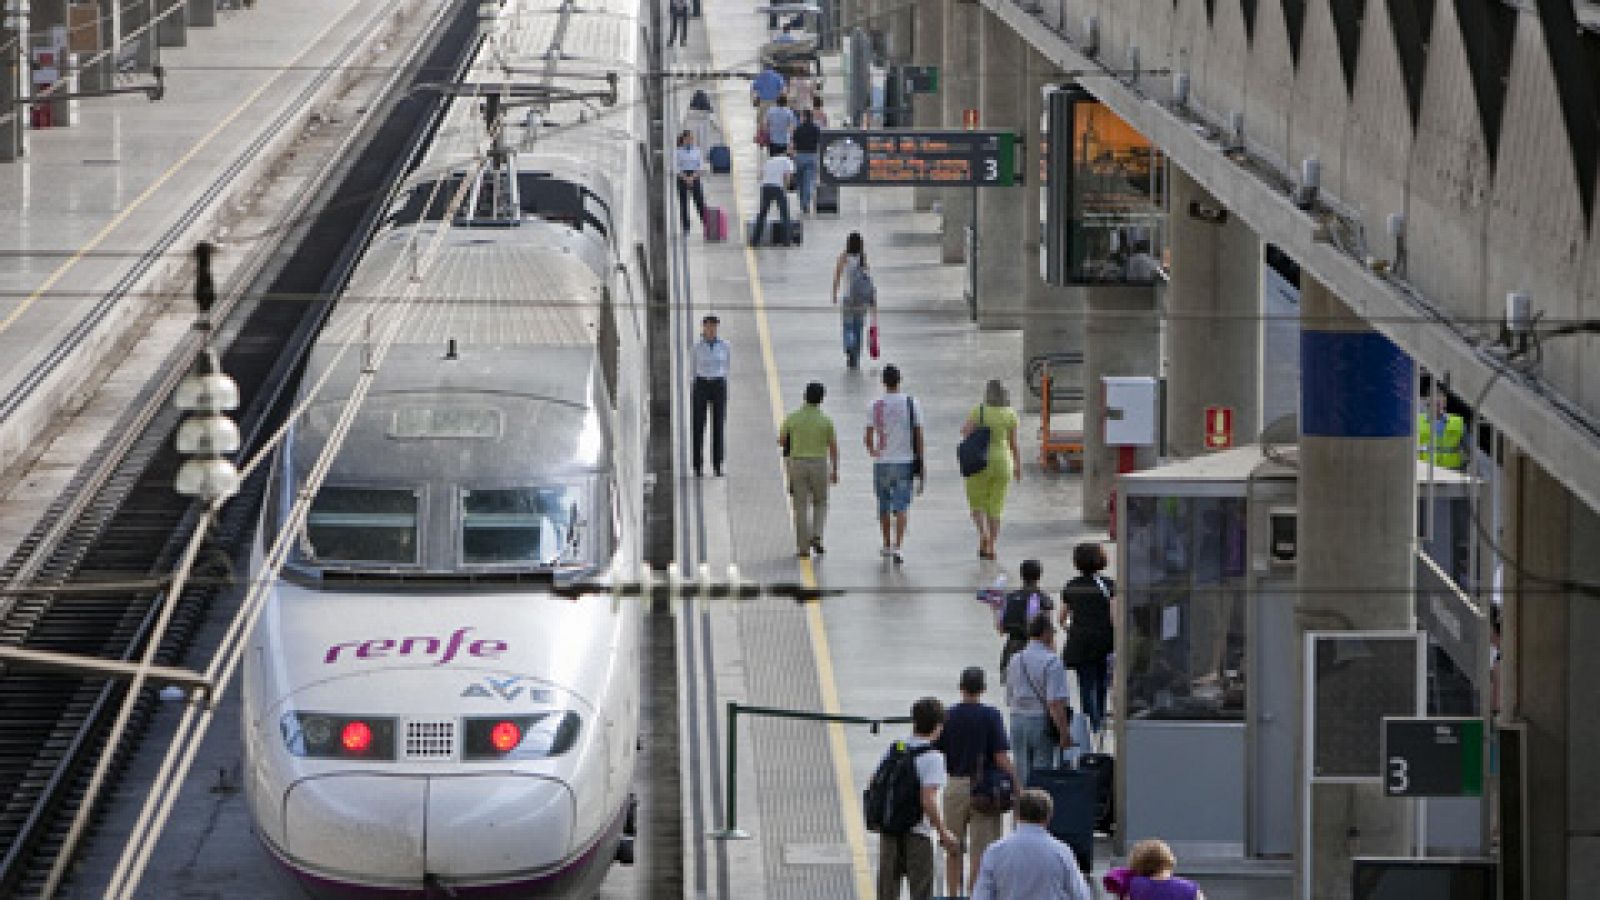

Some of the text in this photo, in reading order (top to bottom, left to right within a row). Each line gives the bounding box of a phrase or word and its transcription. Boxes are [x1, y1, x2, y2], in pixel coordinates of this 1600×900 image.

[982, 158, 998, 181] 3
[323, 626, 508, 667] renfe
[460, 675, 556, 704] AVE
[1388, 755, 1411, 795] 3
